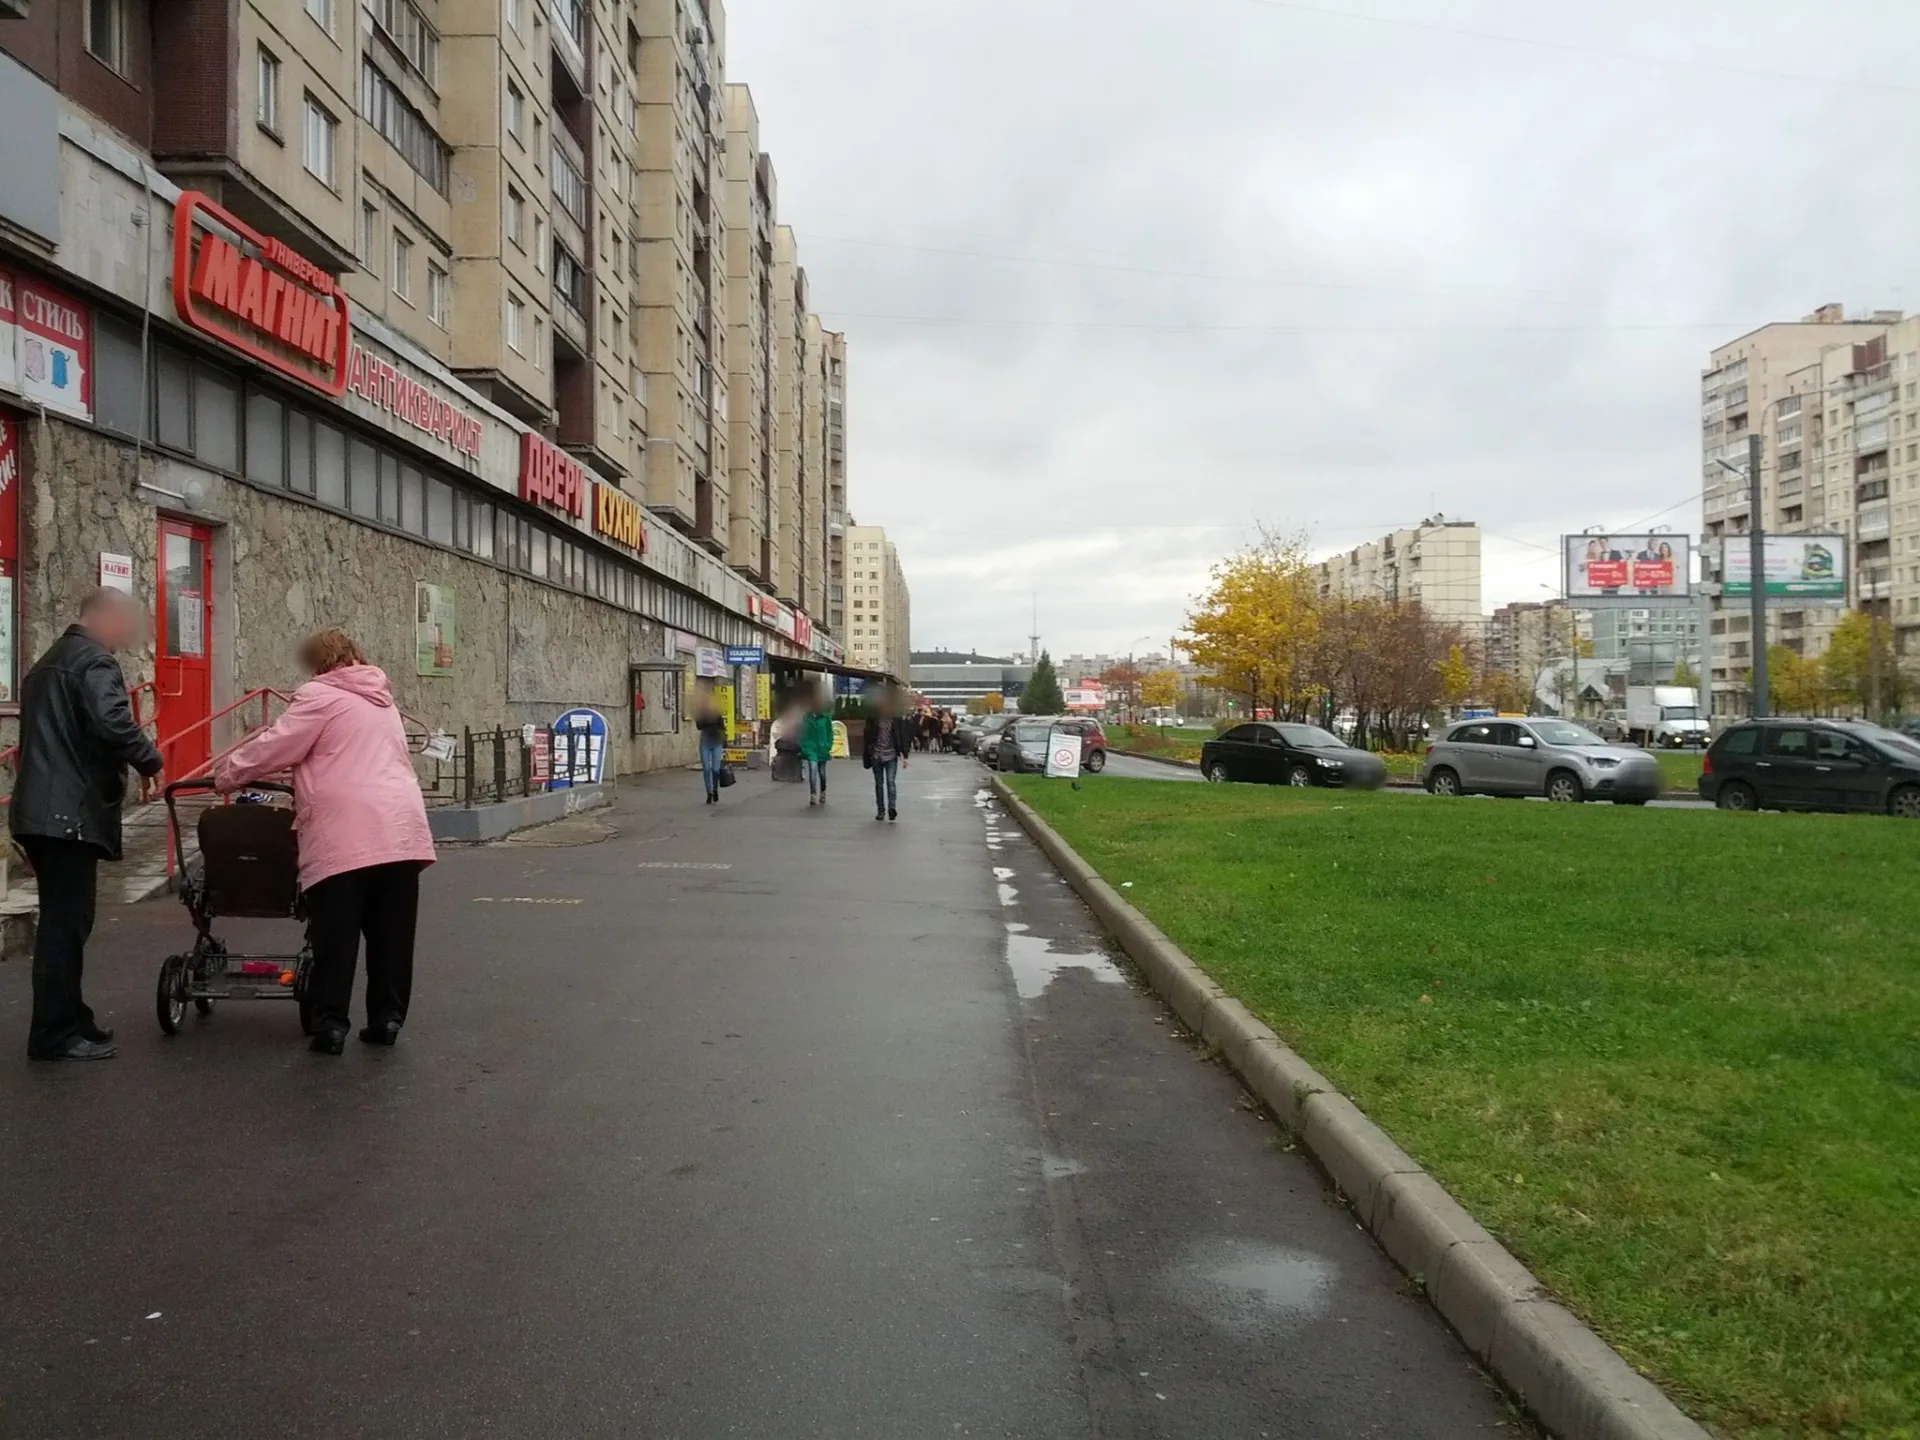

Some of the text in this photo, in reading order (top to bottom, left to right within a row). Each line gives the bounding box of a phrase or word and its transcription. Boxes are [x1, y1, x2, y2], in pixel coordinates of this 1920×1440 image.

[196, 232, 341, 368] МАГНИТ
[269, 236, 334, 296] УНИВЕРСАМ
[23, 289, 84, 341] СТИЛЬ
[347, 342, 482, 461] АНТИКВАРИАТ
[522, 432, 585, 519] ДВЕРИ
[597, 483, 641, 551] КУХНИ
